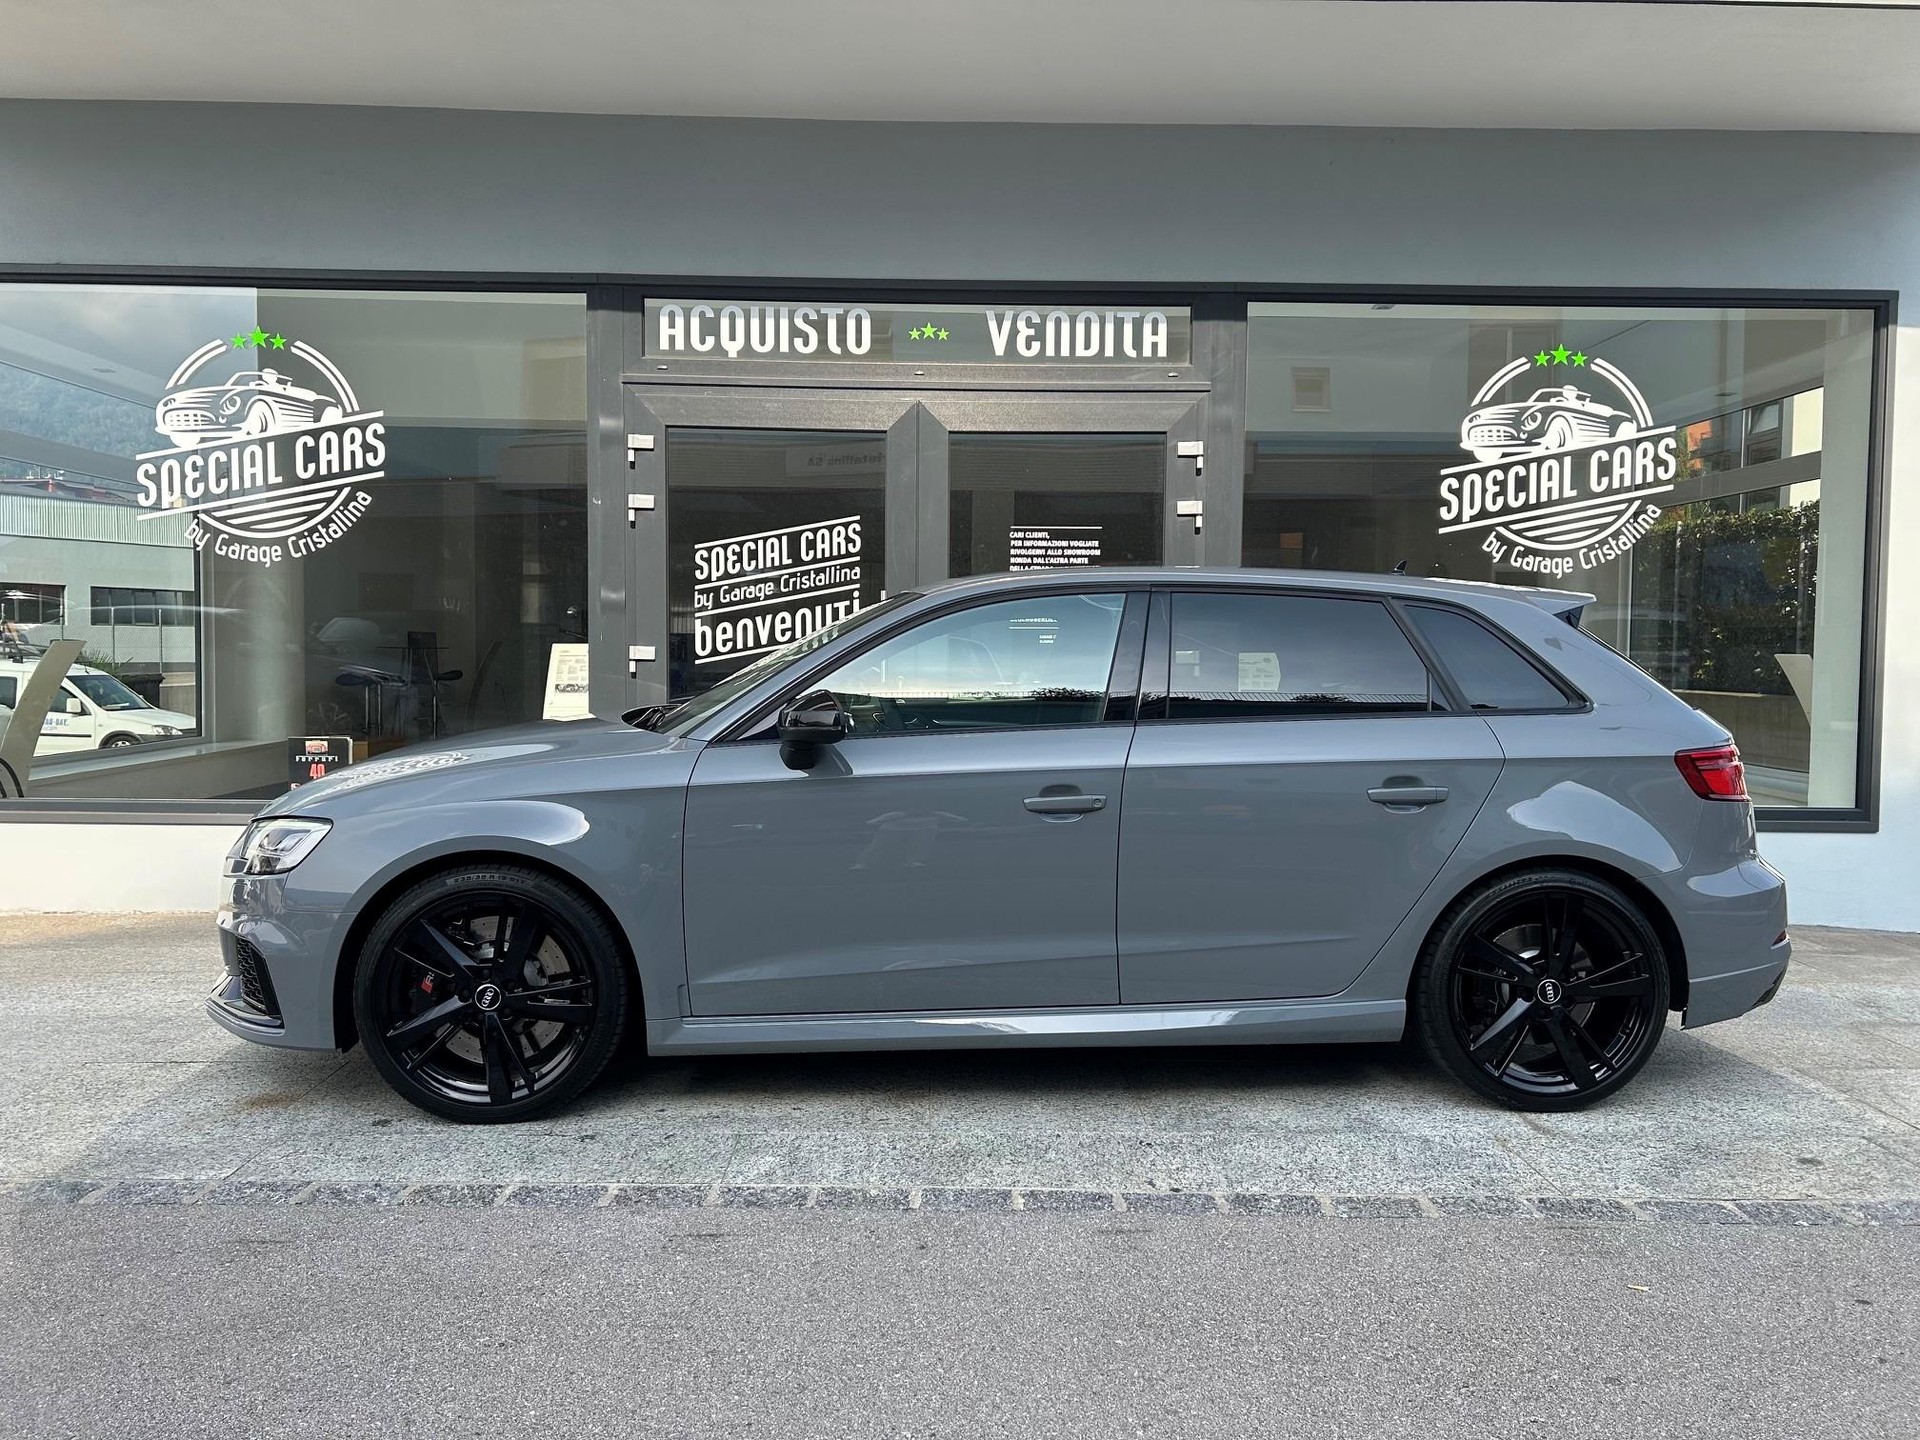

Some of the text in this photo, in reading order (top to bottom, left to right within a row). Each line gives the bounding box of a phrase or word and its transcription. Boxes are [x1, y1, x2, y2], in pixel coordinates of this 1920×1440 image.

[658, 304, 1168, 358] ACQUISTO VENDITA
[136, 422, 386, 509] SPECIAL CARS
[1439, 437, 1677, 523] SPECIAL CARS
[184, 490, 373, 568] by Garage Cristallina
[694, 522, 862, 582] SPECIAL CARS
[1009, 531, 1050, 539] CARI CLIENTI,
[1010, 548, 1045, 556] RIVOLGERVI
[1069, 540, 1100, 548] VOGLIATE
[1481, 503, 1662, 579] by Garage Cristallina
[694, 566, 861, 610] by Garage Cristallina
[309, 763, 325, 779] 40
